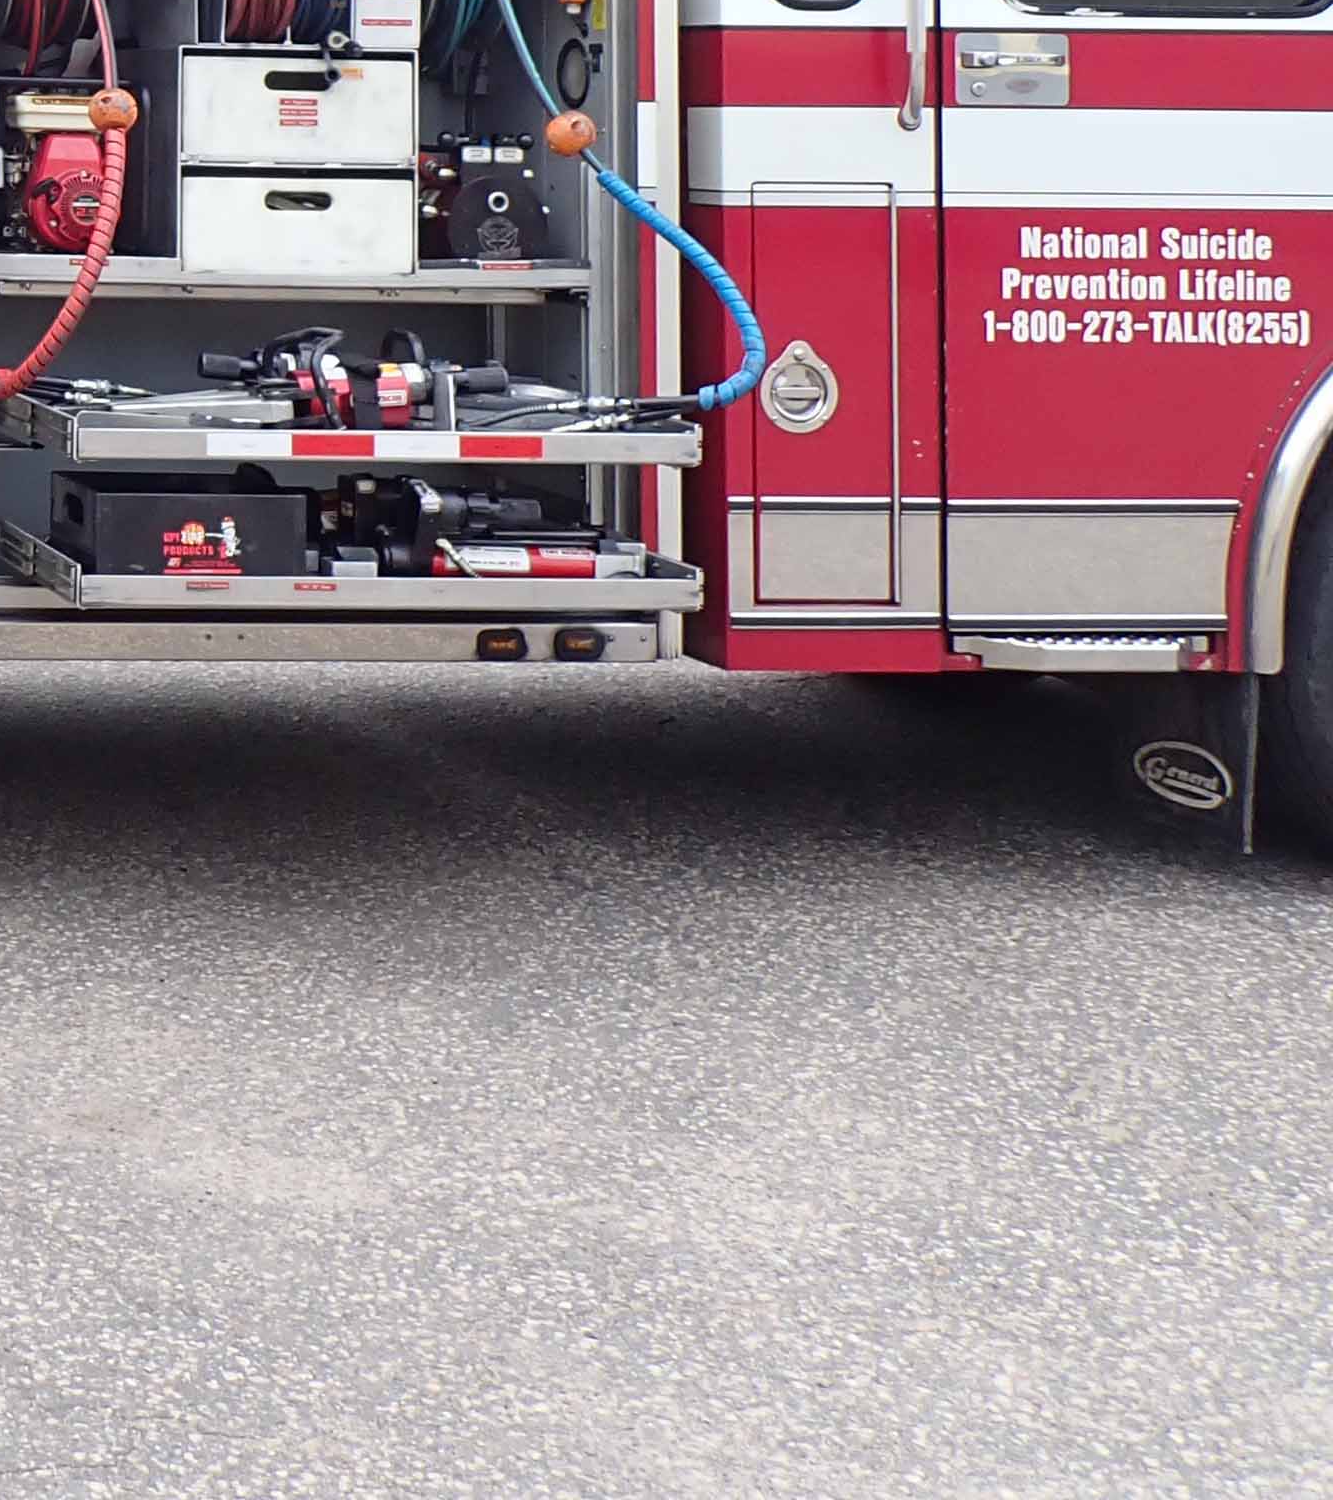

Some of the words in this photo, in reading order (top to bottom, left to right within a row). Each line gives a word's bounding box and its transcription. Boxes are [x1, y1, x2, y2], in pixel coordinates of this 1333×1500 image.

[1020, 226, 1148, 260] National
[1161, 227, 1273, 261] Suicide
[1001, 267, 1167, 301] Prevention
[1179, 268, 1292, 302] Lifeline
[983, 309, 1311, 347] 1-800-273-TALK(8255)
